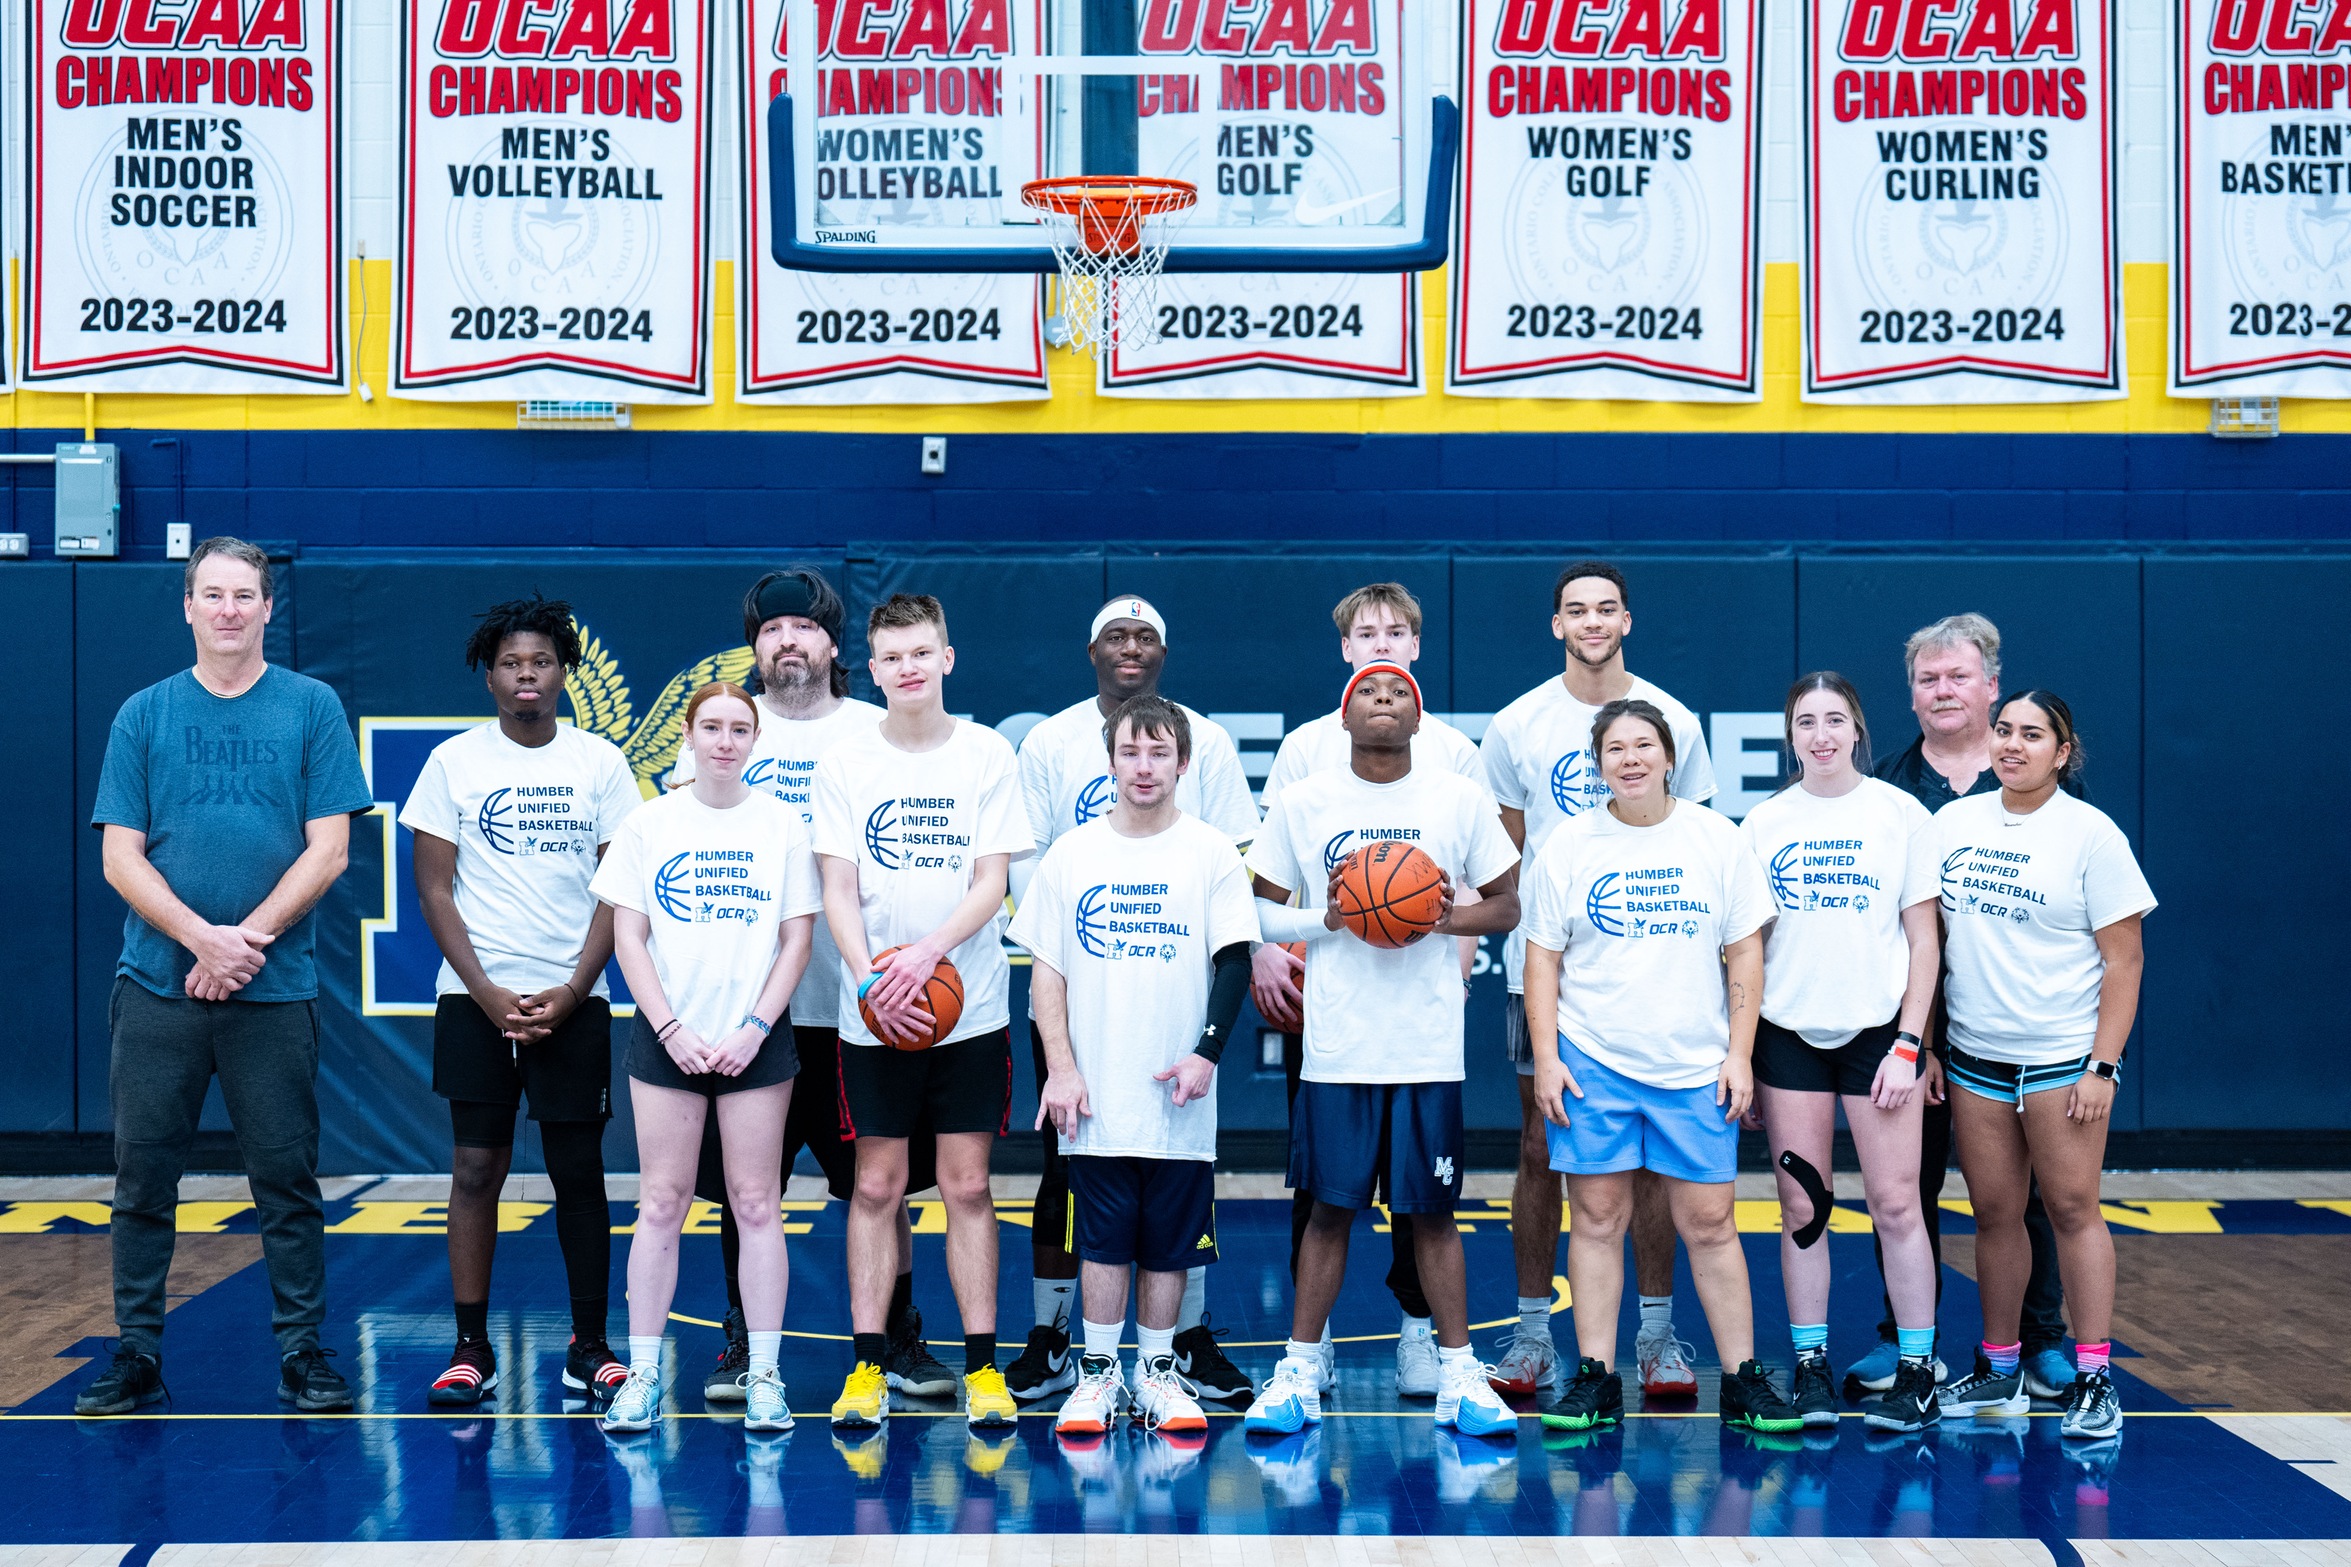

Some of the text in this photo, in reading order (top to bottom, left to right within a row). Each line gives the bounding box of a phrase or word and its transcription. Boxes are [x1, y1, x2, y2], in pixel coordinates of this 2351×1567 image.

[60, 0, 307, 50] OCAA
[433, 0, 676, 62] OCAA
[1138, 0, 1377, 57] OCAA
[1493, 0, 1726, 62] OCAA
[1837, 0, 2080, 64] OCAA
[56, 55, 313, 112] CHAMPIONS
[429, 64, 682, 123] CHAMPIONS
[1138, 62, 1386, 117] CHMPIONS
[1488, 64, 1731, 123] CHAMPIONS
[1833, 67, 2086, 123] CHAMPIONS
[2204, 61, 2351, 116] CHAMP
[127, 118, 242, 151] MEN'S
[502, 127, 610, 161] MEN'S
[817, 127, 983, 162] WOMEN'S
[1527, 126, 1692, 161] WOMEN'S
[1877, 128, 2048, 164] WOMEN'S
[115, 156, 254, 190] INDOOR
[448, 164, 663, 201] VOLLEYBALL
[818, 165, 1003, 201] OLLEYBALL
[1217, 163, 1302, 196] GOLF
[1567, 165, 1651, 198] GOLF
[1886, 167, 2039, 201] CURLING
[2222, 161, 2351, 195] BASKET
[110, 194, 257, 228] SOCCER
[815, 230, 876, 244] SPALDING
[80, 298, 287, 333] 2023-2024
[450, 306, 653, 343] 2023-2024
[797, 307, 1000, 344] 2023-2024
[1161, 304, 1362, 340] 2023-2024
[1507, 304, 1702, 341] 2023-2024
[1860, 307, 2065, 344] 2023-2024
[222, 724, 240, 735] THE
[184, 725, 279, 772] BEATLES
[778, 759, 818, 771] HUMB
[517, 786, 574, 797] HUMBER
[777, 774, 811, 787] UNIFI
[518, 803, 570, 814] UNIFIED
[901, 797, 955, 809] HUMBER
[518, 820, 593, 832] BASKETBALL
[902, 815, 949, 826] UNIFIED
[1360, 829, 1421, 840] HUMBER
[540, 841, 568, 852] OCR
[695, 850, 754, 863] HUMBER
[1804, 840, 1863, 850] HUMBER
[1975, 847, 2031, 864] HUMBER
[695, 867, 748, 879] UNIFIED
[915, 856, 945, 868] OCR
[1625, 867, 1684, 881] HUMBER
[1803, 855, 1855, 867] UNIFIED
[1968, 862, 2019, 879] UNIFIED
[695, 884, 772, 901] BASKETBALL
[1111, 883, 1169, 896] HUMBER
[1625, 884, 1680, 897] UNIFIED
[1803, 873, 1881, 891] BASKETBALL
[1962, 877, 2047, 906] BASKETBALL
[716, 907, 744, 920] OCR
[1110, 902, 1162, 915] UNIFIED
[1626, 900, 1711, 914] BASKETBALL
[1821, 896, 1849, 908] OCR
[1980, 903, 2008, 918] OCR
[1109, 920, 1190, 937] BASKETBALL
[1649, 923, 1678, 935] OCR
[1128, 945, 1156, 958] OCR
